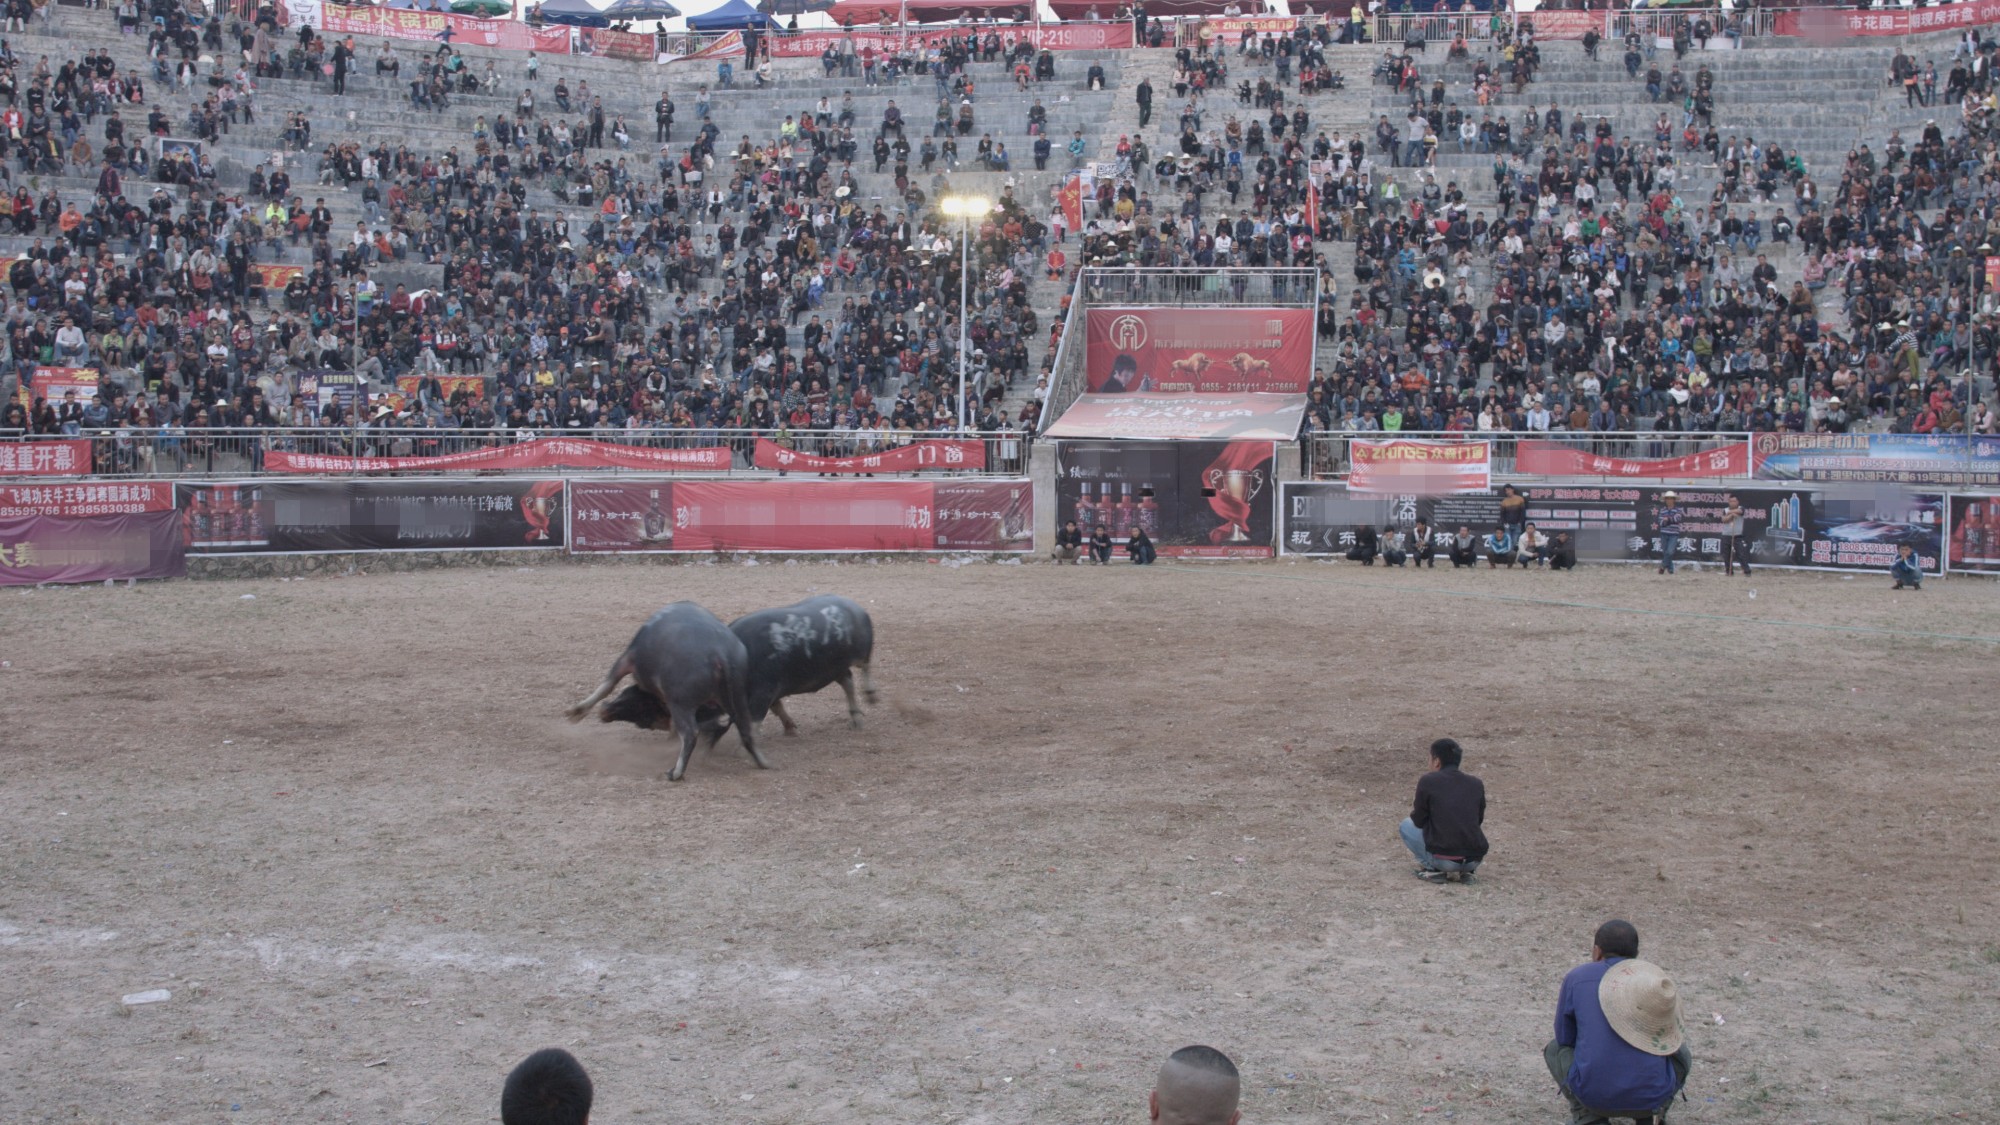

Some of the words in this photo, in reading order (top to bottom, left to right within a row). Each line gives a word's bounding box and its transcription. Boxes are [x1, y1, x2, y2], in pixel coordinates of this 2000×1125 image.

[1841, 8, 1974, 31] 市花园二期现房开盘
